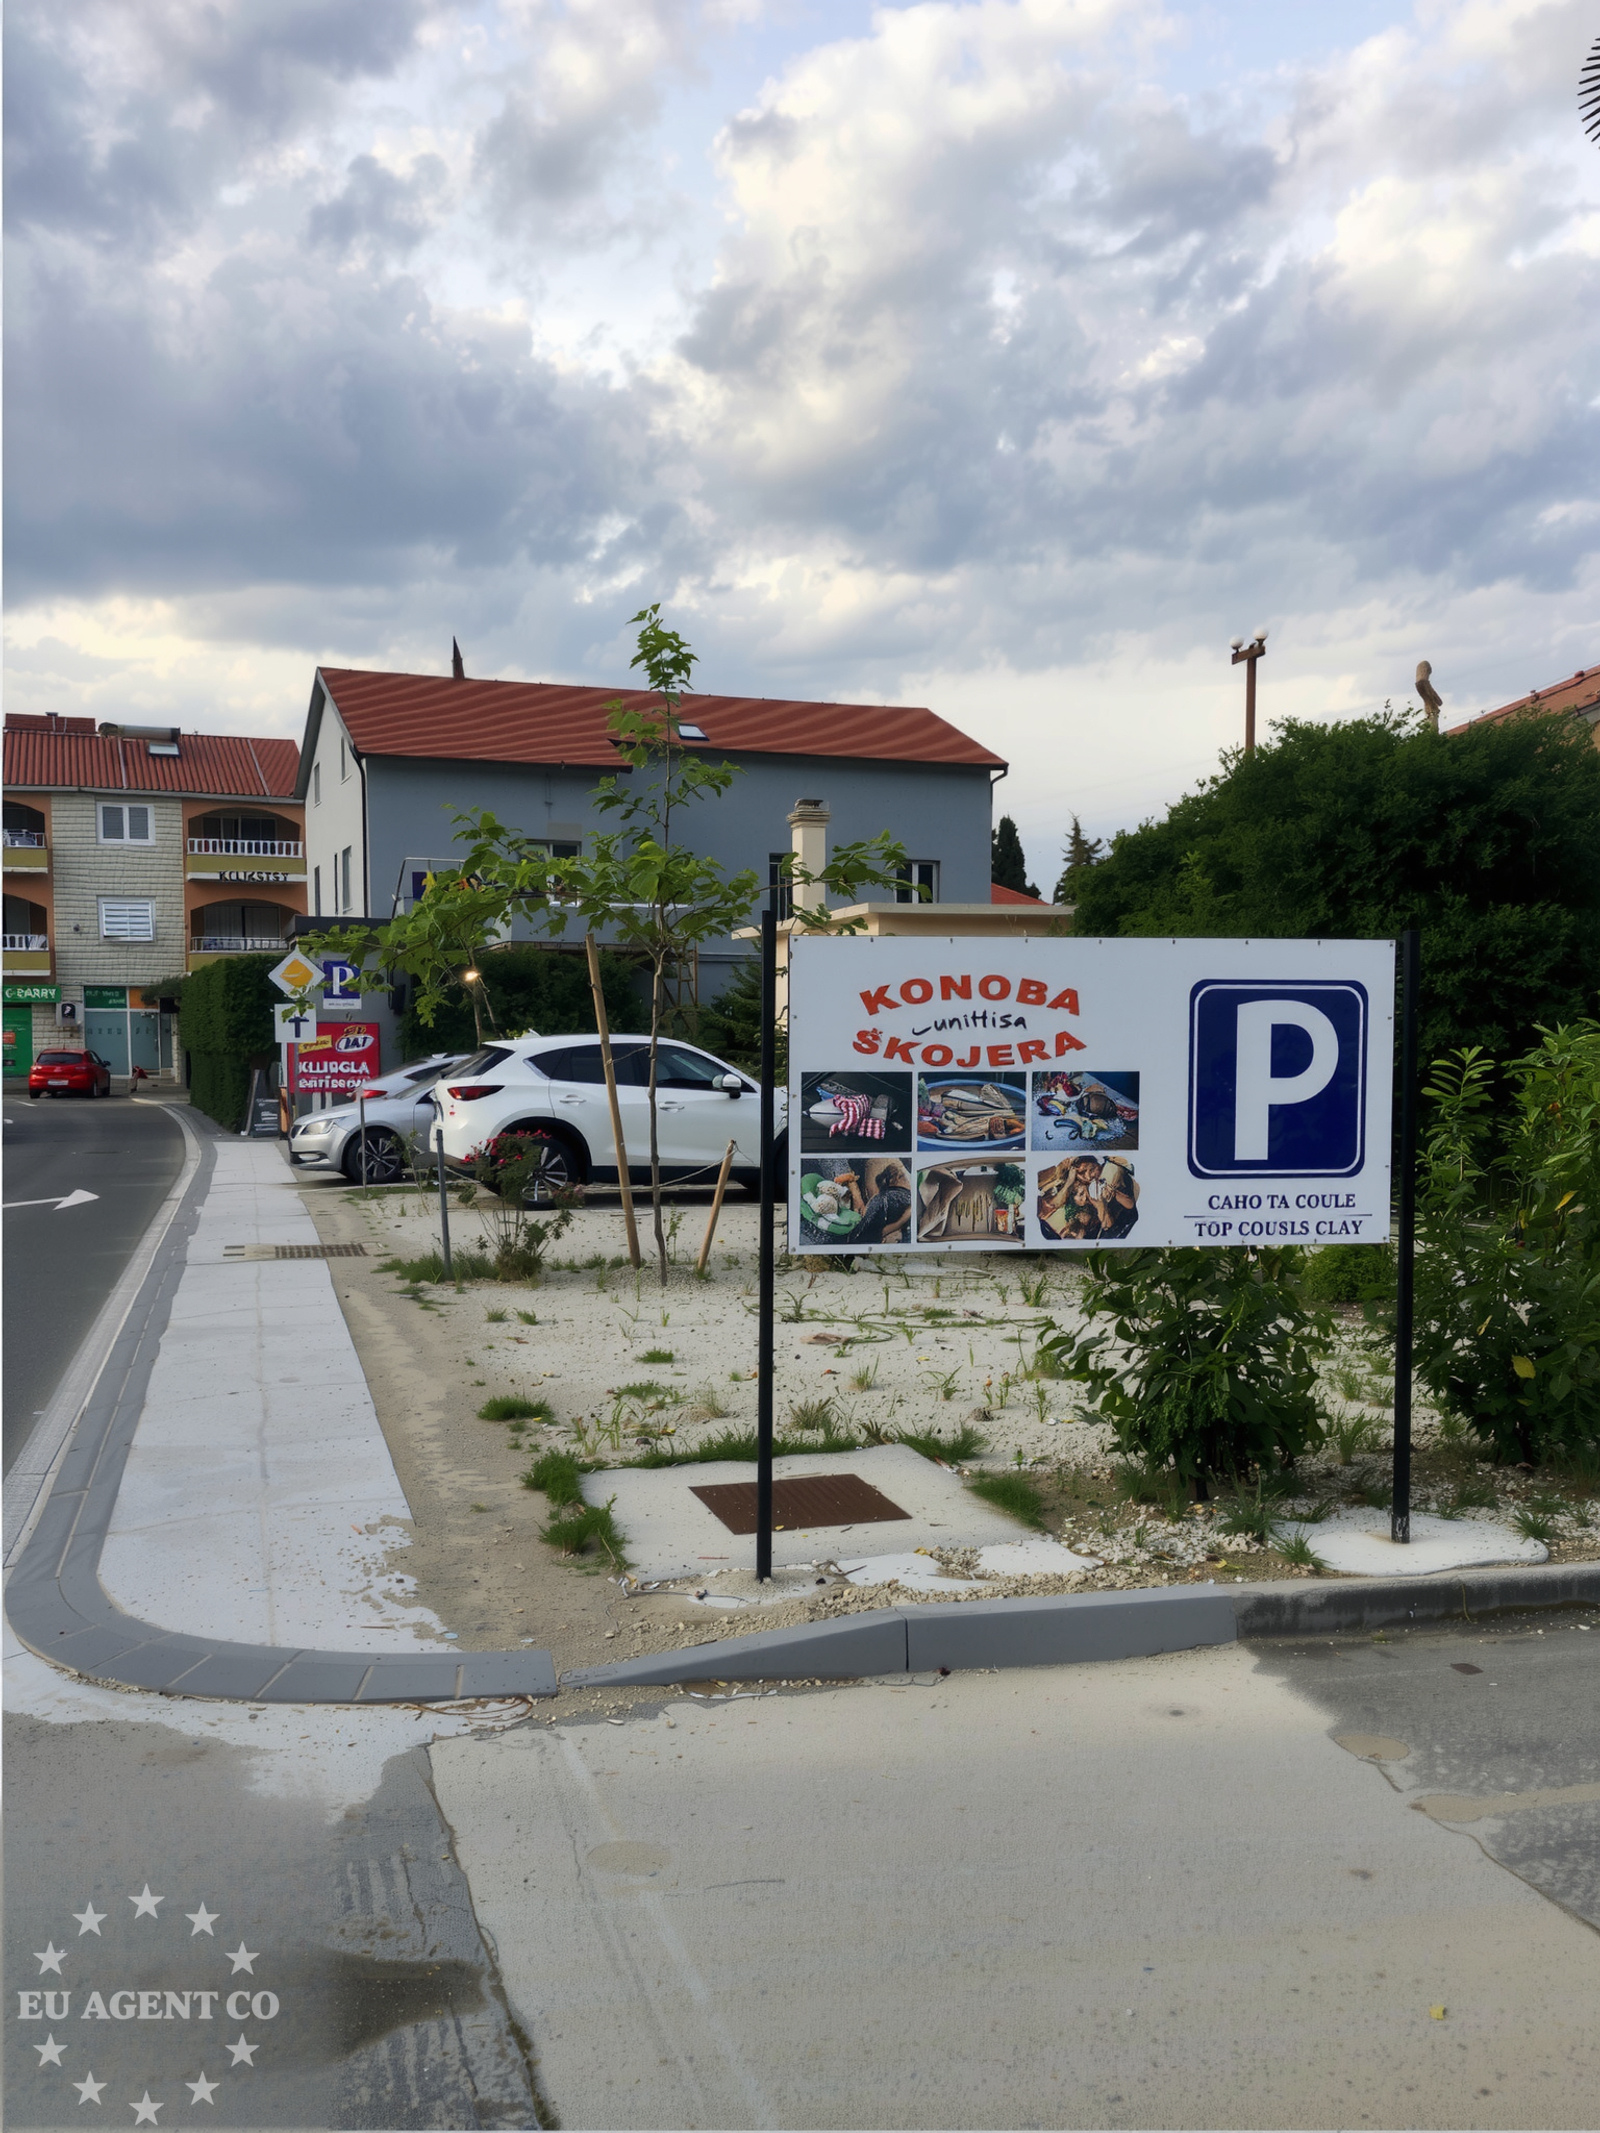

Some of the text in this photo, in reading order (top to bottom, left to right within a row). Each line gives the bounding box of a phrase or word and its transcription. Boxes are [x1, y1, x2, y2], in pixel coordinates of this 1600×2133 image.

[859, 974, 1080, 1016] KONOBA
[1234, 1000, 1340, 1162] P
[1208, 1193, 1356, 1210] CAHO TA COULE
[1194, 1221, 1233, 1237] TOP
[1315, 1219, 1363, 1236] CLAY
